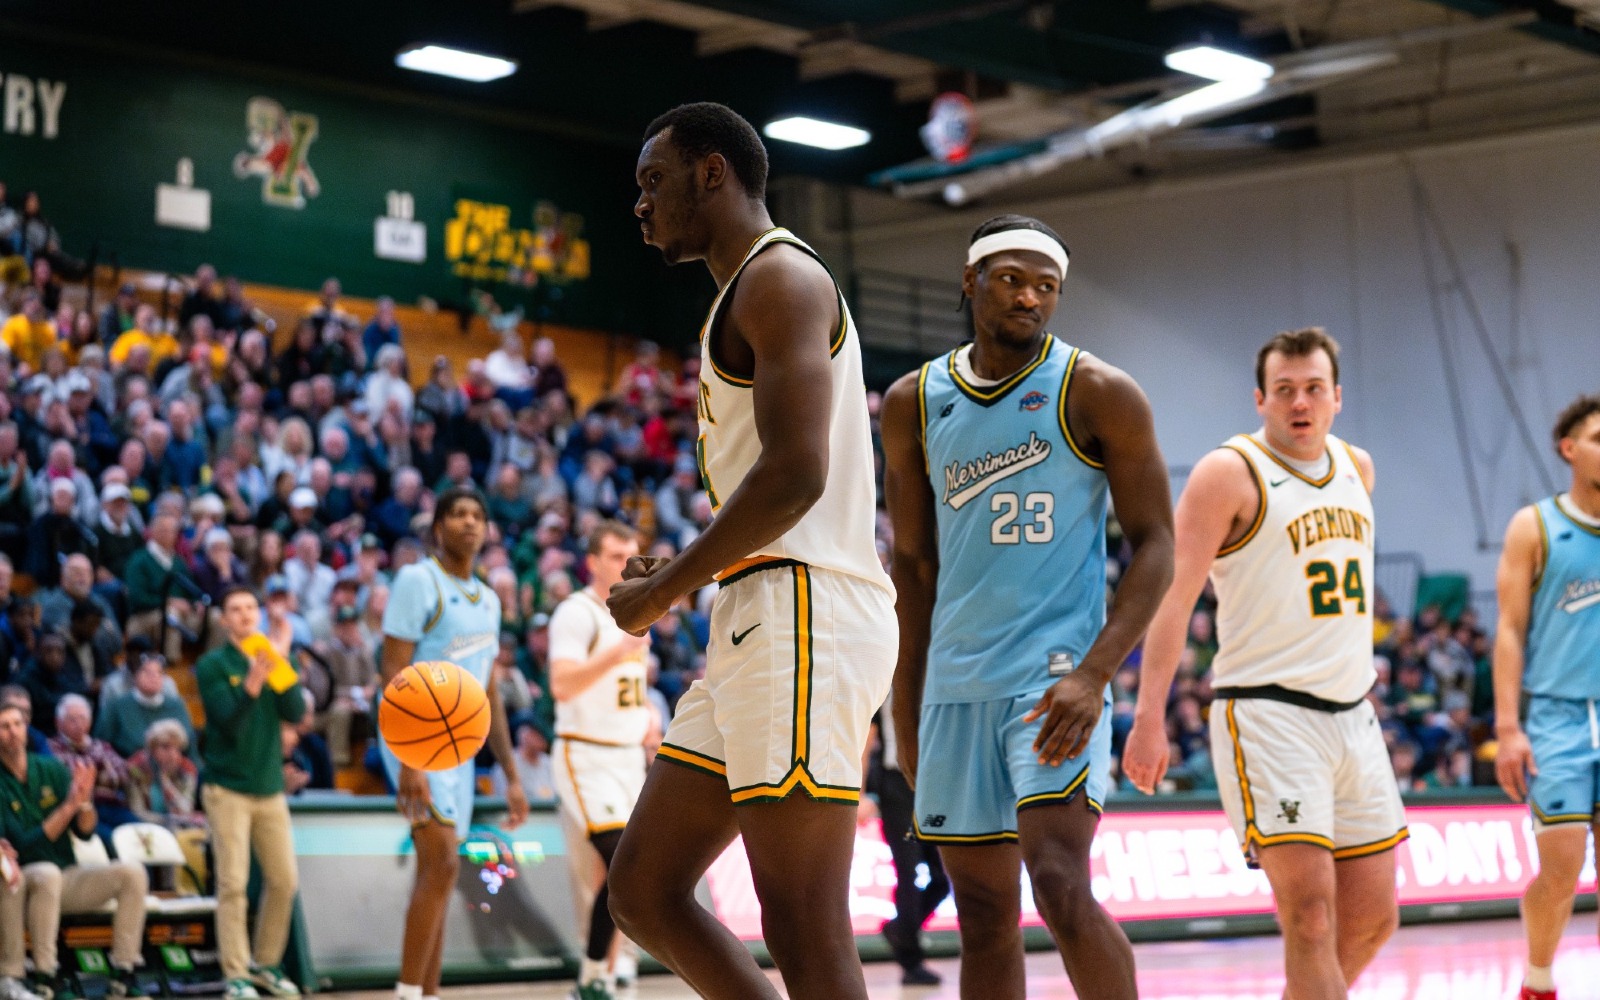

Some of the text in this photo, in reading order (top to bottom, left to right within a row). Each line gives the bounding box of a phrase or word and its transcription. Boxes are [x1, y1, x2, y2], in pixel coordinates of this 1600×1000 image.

[0, 71, 67, 138] RY
[942, 431, 1051, 505] Merrimack
[991, 491, 1056, 545] 23
[1304, 557, 1368, 620] 24
[1407, 820, 1523, 888] DAY!
